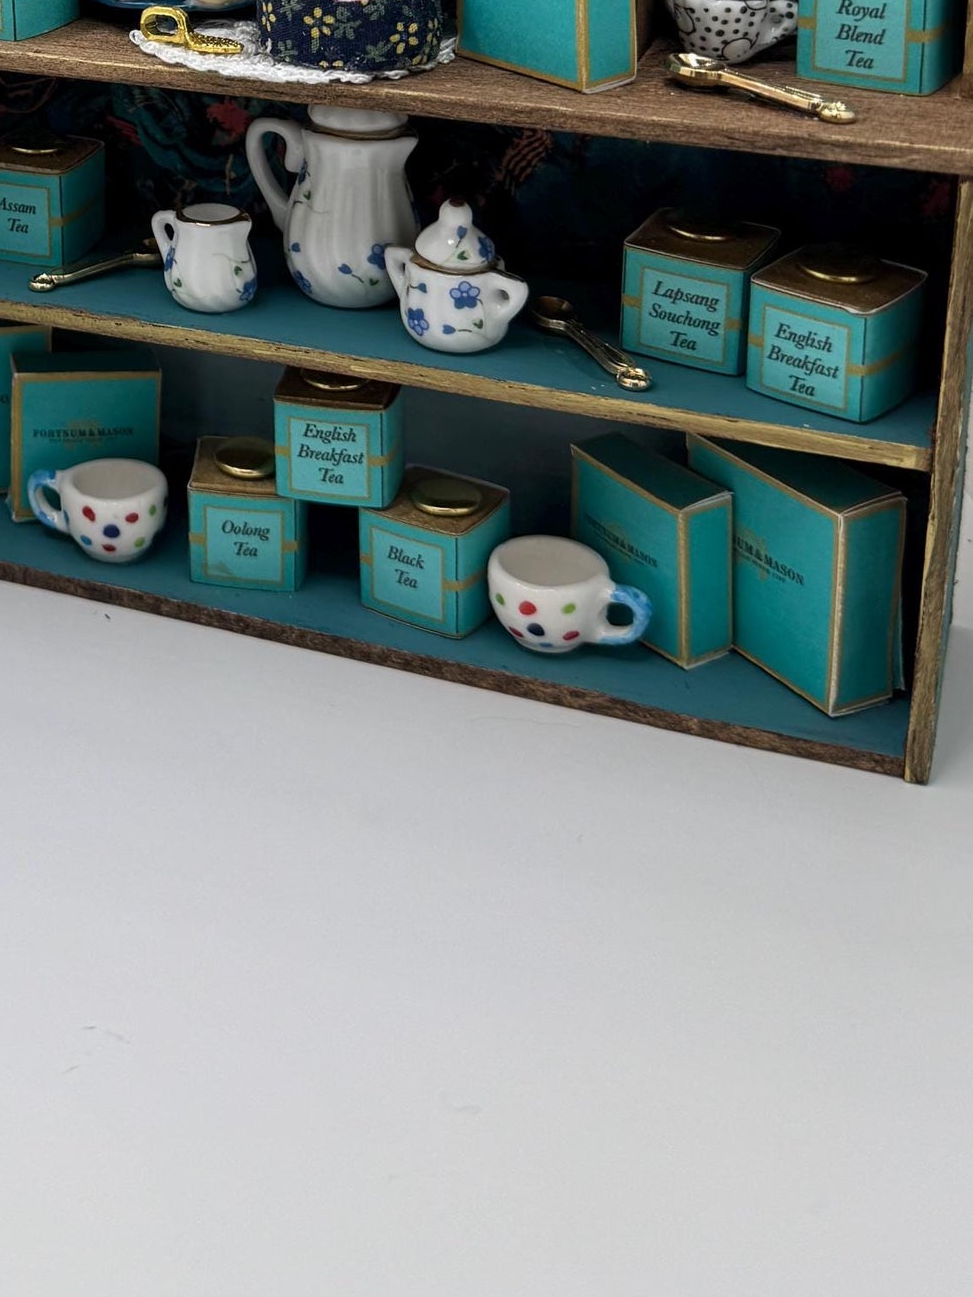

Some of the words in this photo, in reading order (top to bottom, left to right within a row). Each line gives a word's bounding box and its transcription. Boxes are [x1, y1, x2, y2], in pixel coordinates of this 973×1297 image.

[835, 22, 885, 48] Blend
[844, 49, 876, 72] Tea
[7, 218, 30, 235] Tea
[652, 280, 720, 313] Lapsang
[648, 303, 722, 337] Souchong
[669, 328, 698, 352] Tea
[775, 322, 834, 355] English
[767, 343, 841, 379] Breakfast
[788, 375, 817, 398] Tea
[302, 423, 358, 444] English
[296, 443, 365, 467] Breakfast
[318, 467, 345, 485] Tea
[221, 519, 271, 542] Oolong
[234, 540, 259, 558] Tea
[386, 546, 426, 571] Black
[394, 569, 420, 590] Tea
[763, 553, 805, 587] MASON
